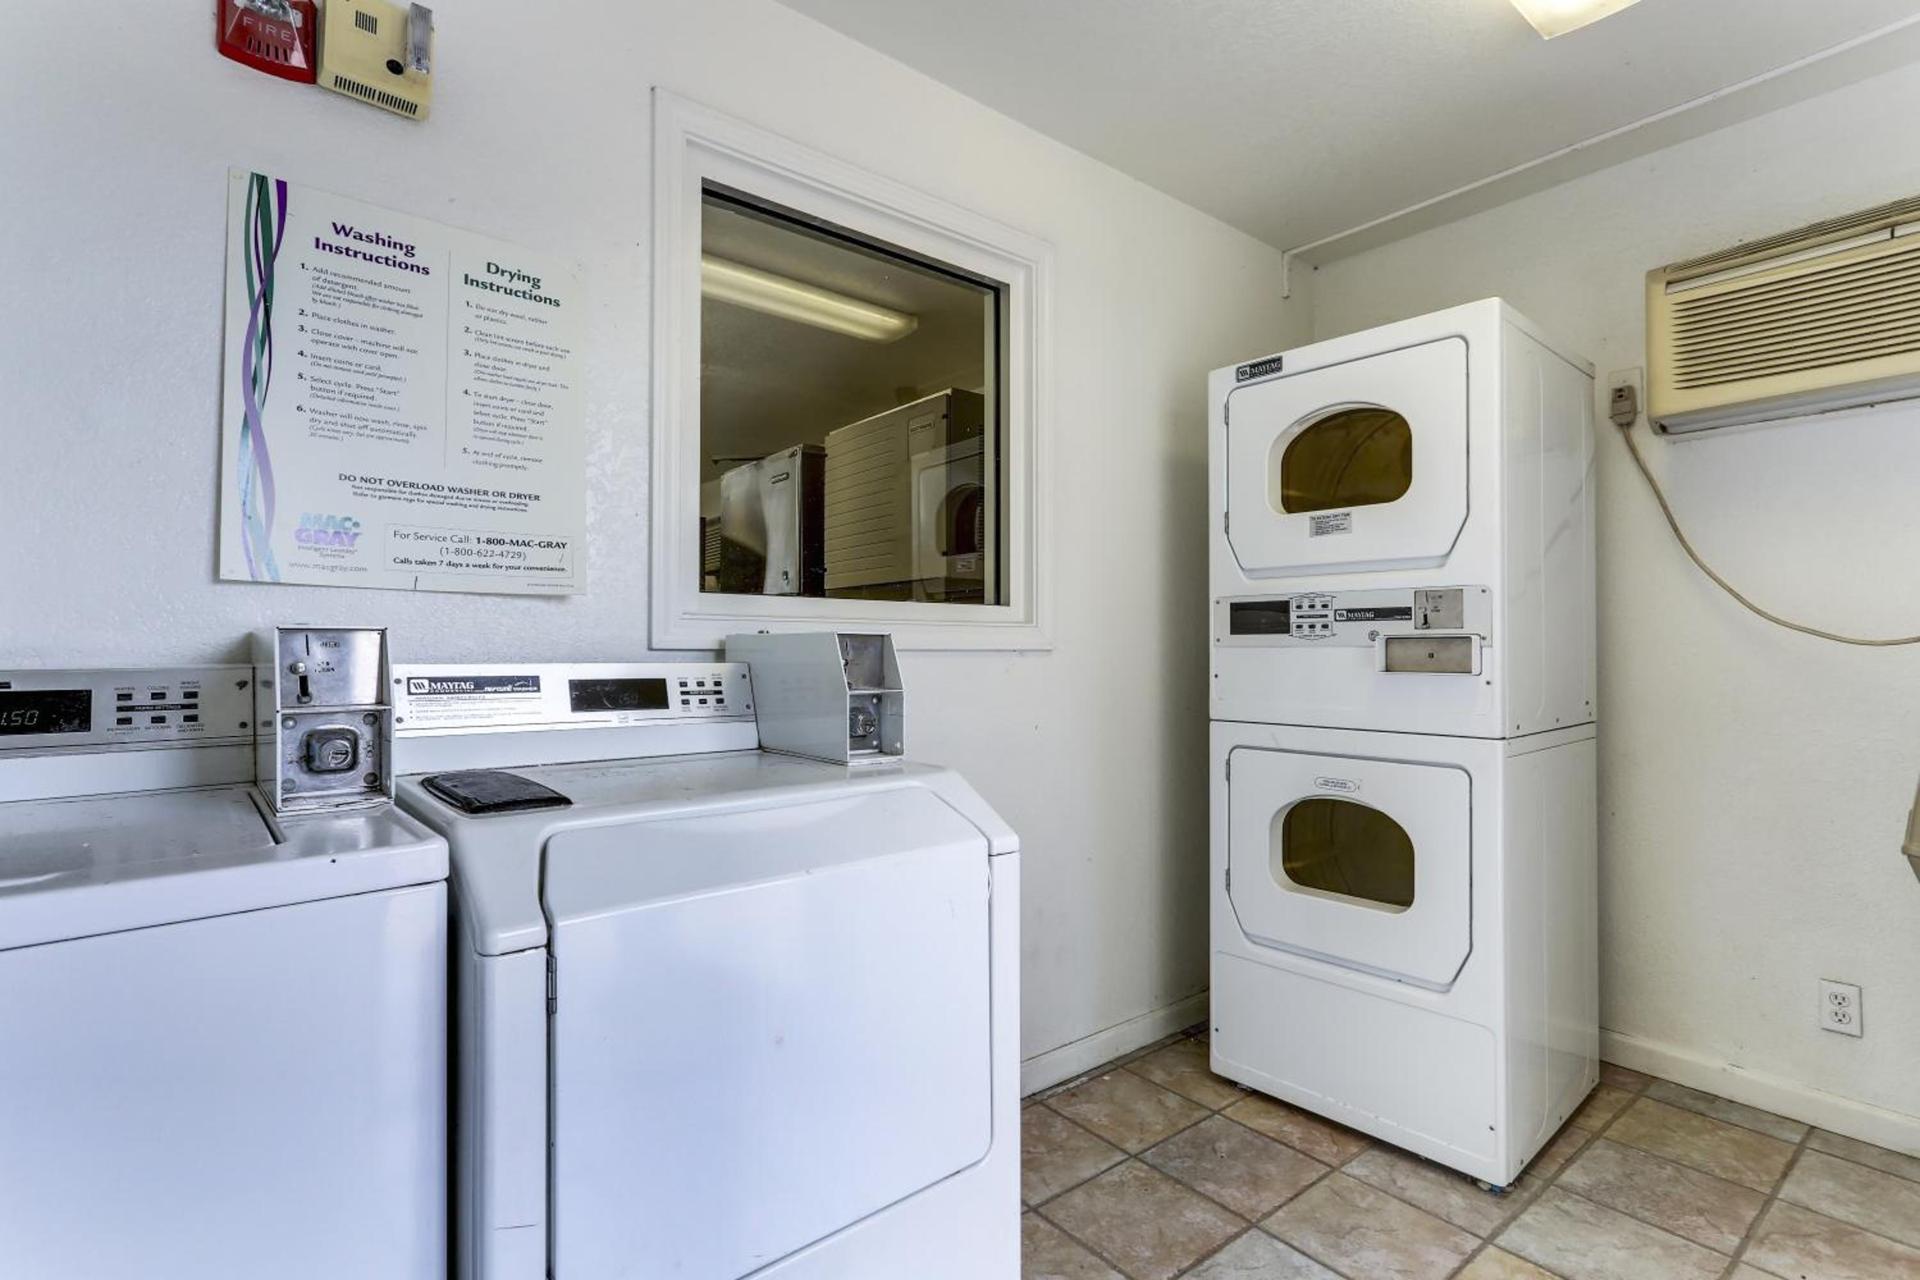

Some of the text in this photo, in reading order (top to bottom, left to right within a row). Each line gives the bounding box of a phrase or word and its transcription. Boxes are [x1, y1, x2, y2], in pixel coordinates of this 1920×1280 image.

[242, 16, 292, 42] FIRE
[332, 221, 416, 257] Washing
[314, 237, 430, 276] Instructions
[300, 262, 309, 271] 1.
[312, 266, 328, 275] Add
[330, 271, 382, 287] recommended
[486, 261, 542, 290] Drying
[464, 273, 561, 308] Instructions
[298, 308, 309, 316] 2.
[311, 311, 331, 322] Place
[333, 318, 359, 328] clothes
[465, 300, 473, 308] 1.
[498, 309, 508, 317] dry
[297, 325, 308, 333] 3.
[311, 328, 333, 338] Close
[333, 334, 354, 342] cover
[360, 338, 391, 349] machine
[464, 326, 473, 334] 2.
[474, 329, 494, 337] Clean
[526, 340, 545, 349] before
[310, 338, 340, 349] operate
[341, 343, 358, 351] with
[359, 348, 377, 356] cover
[297, 350, 308, 358] 4.
[310, 352, 331, 362] Insert
[333, 358, 353, 366] coins
[463, 349, 472, 357] 3.
[474, 352, 491, 361] Place
[492, 356, 514, 365] clothes
[297, 373, 307, 381] 5.
[310, 375, 332, 385] Select
[355, 383, 374, 392] Press
[310, 383, 336, 394] button
[462, 388, 472, 396] 4.
[499, 395, 515, 404] dryer
[296, 404, 307, 413] 6.
[309, 408, 338, 417] Washer
[339, 412, 353, 420] will
[338, 473, 541, 502] DO NOT OVERLOAD WASHER OR DRYER
[364, 486, 397, 494] responsible
[294, 528, 362, 548] GRAY
[393, 530, 568, 550] For Service Call: 1-800-MAC-GRAY
[439, 547, 527, 561] (1-800-622-4729)
[393, 556, 413, 566] Calls
[414, 558, 437, 566] taken
[446, 560, 463, 569] days
[471, 561, 491, 569] week
[492, 562, 503, 570] for
[505, 564, 521, 572] your
[522, 565, 568, 573] convenience.
[430, 681, 475, 690] MAYTAG
